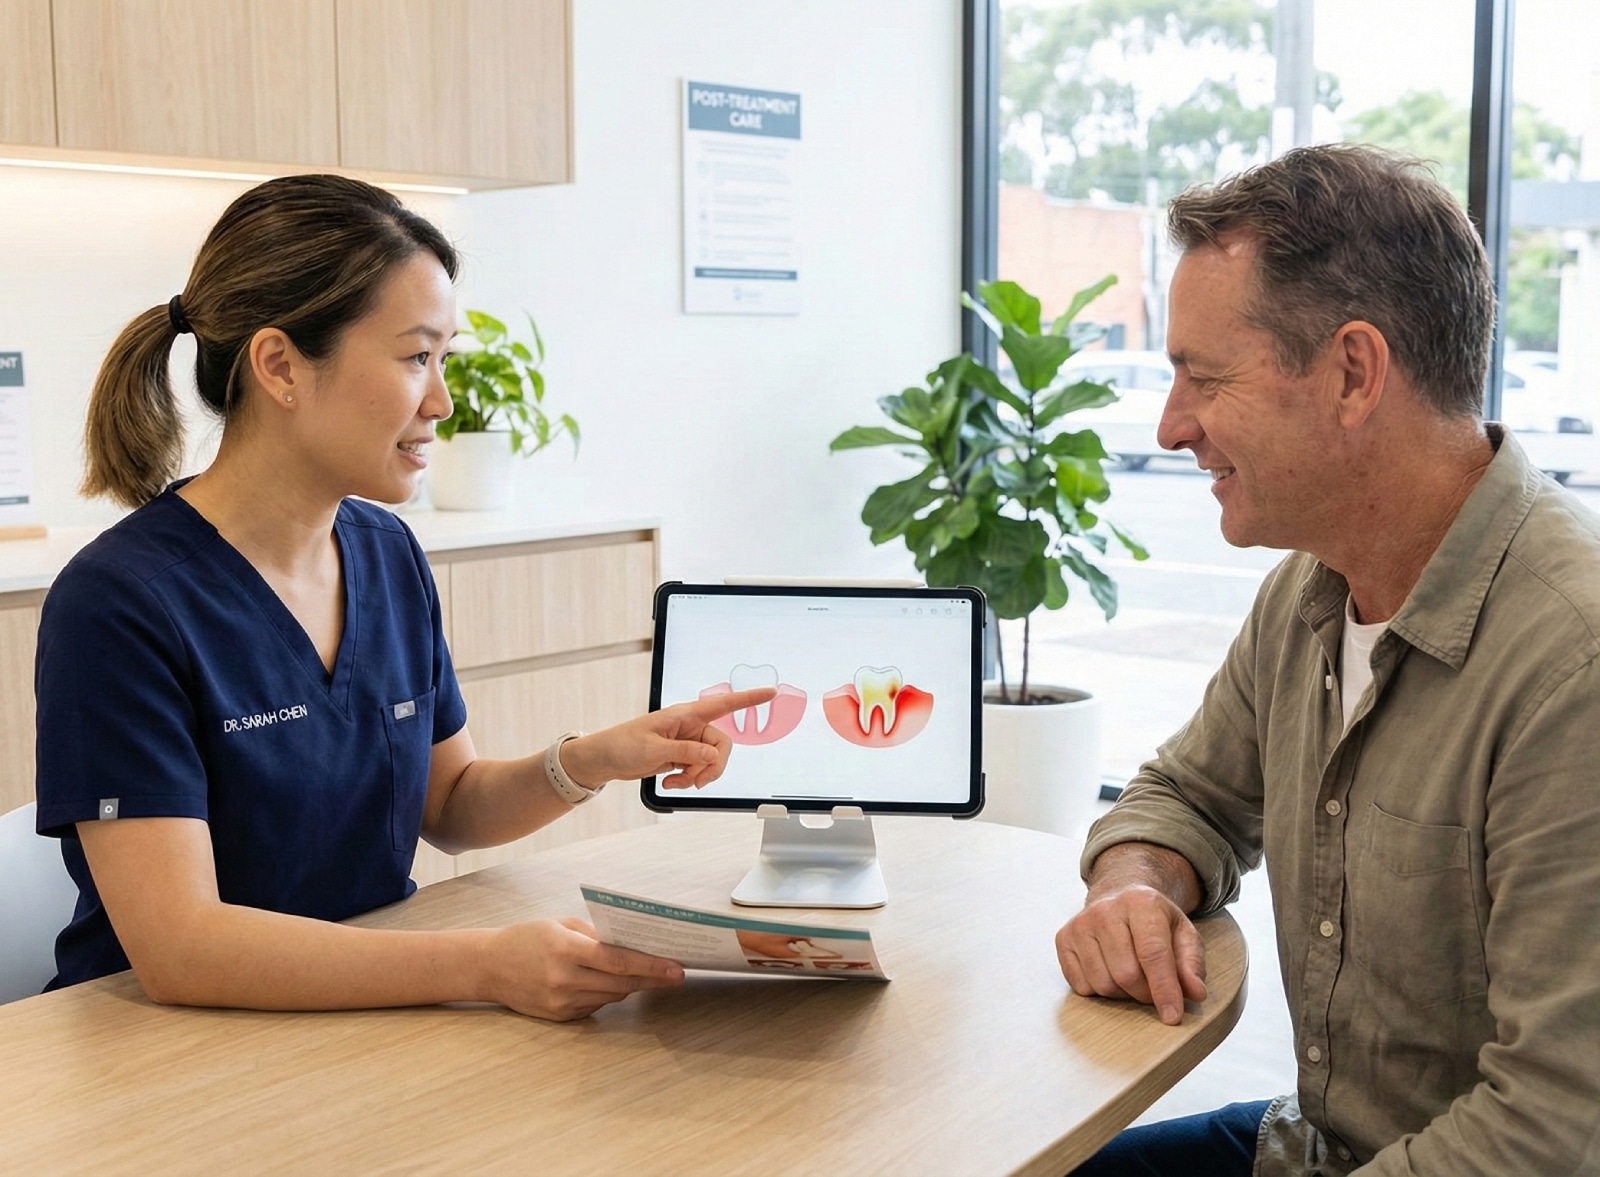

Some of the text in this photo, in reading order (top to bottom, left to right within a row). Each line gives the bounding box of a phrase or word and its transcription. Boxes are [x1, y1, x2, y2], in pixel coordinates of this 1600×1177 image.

[692, 89, 798, 115] POST-TREATMENT
[729, 111, 763, 129] CARE
[241, 711, 278, 730] SARAH
[279, 704, 308, 721] CHEN
